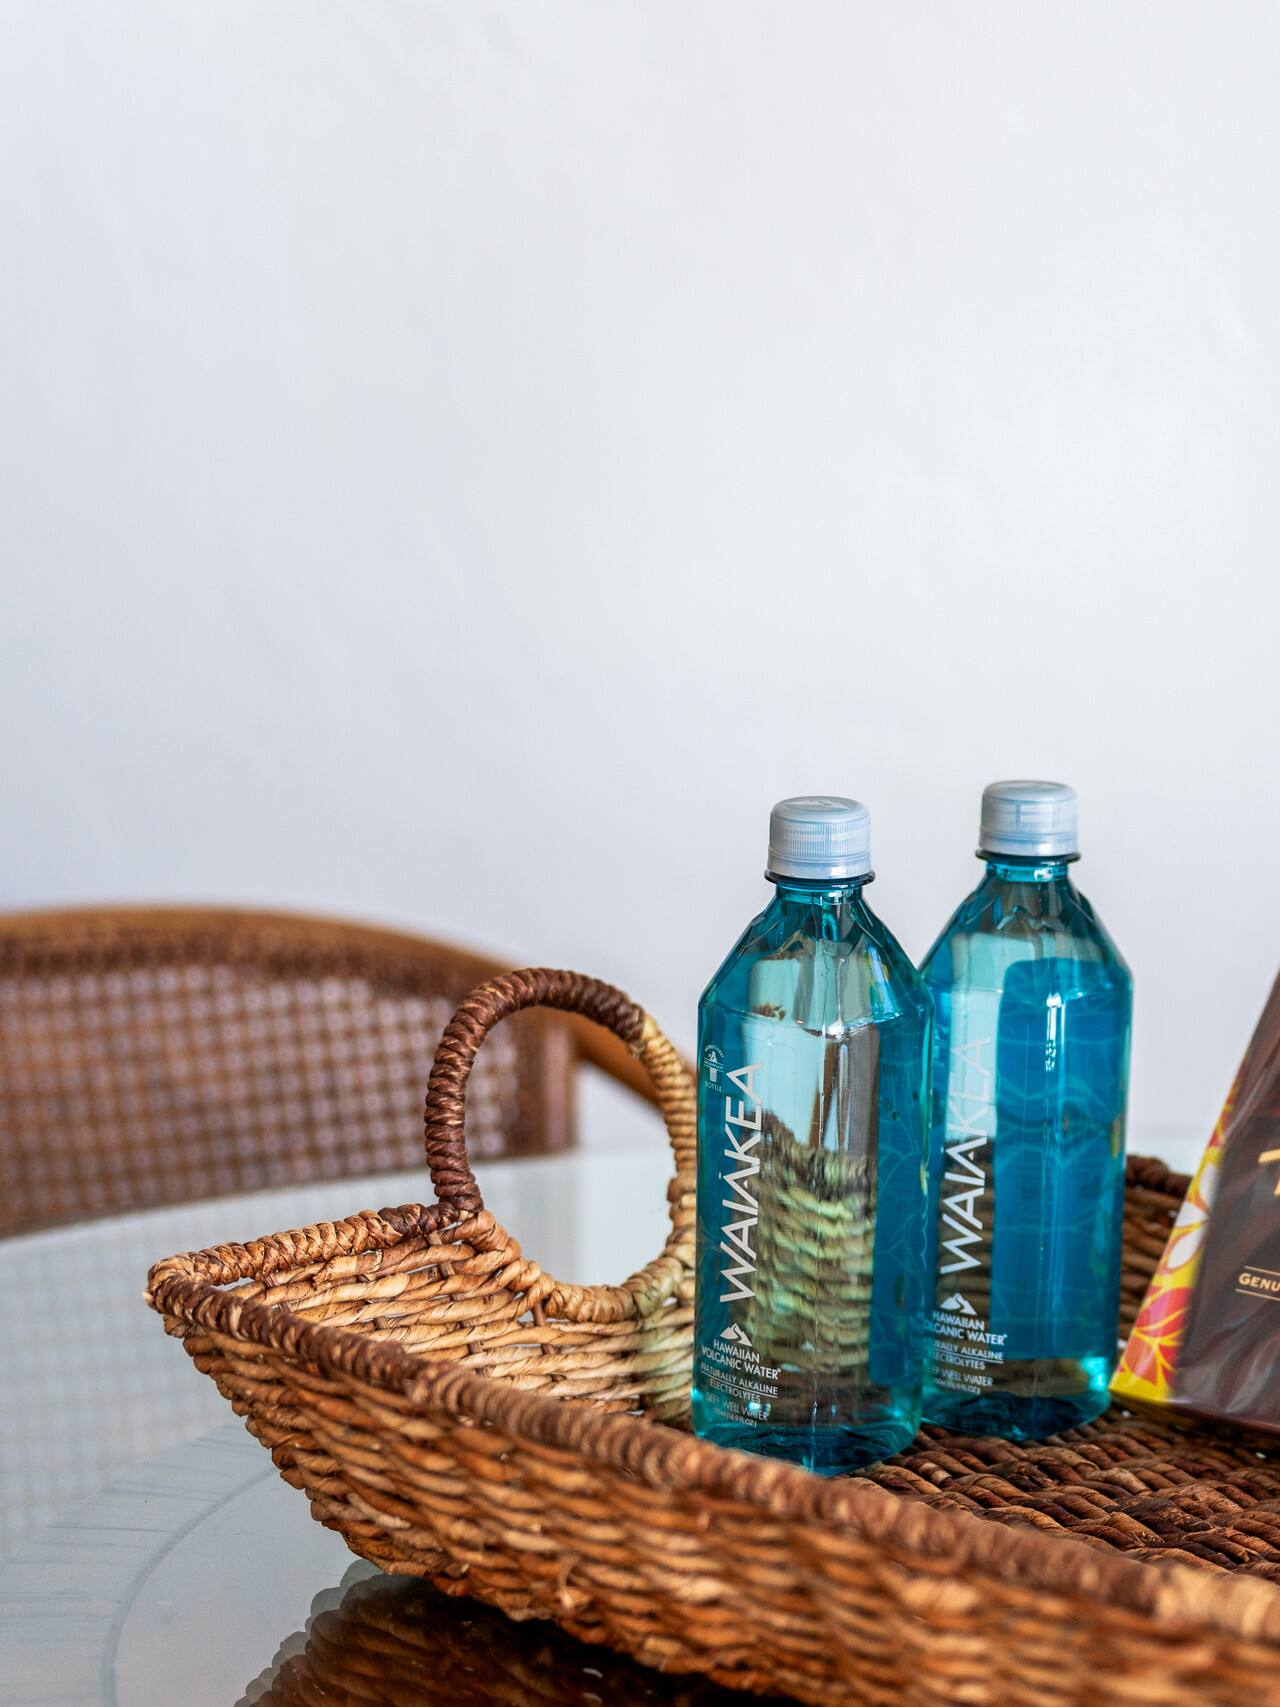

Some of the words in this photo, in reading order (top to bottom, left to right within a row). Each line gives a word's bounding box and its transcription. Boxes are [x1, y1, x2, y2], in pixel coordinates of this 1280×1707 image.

[933, 1311, 985, 1331] HAWAIIAN
[702, 1344, 742, 1370] VOLCANIC
[713, 1339, 760, 1364] HAWAIIAN
[961, 1346, 1004, 1360] ALKALINE
[701, 1362, 737, 1383] NATURALLY
[739, 1379, 778, 1395] ALKALINE
[710, 1379, 761, 1402] ELECTROLYTES
